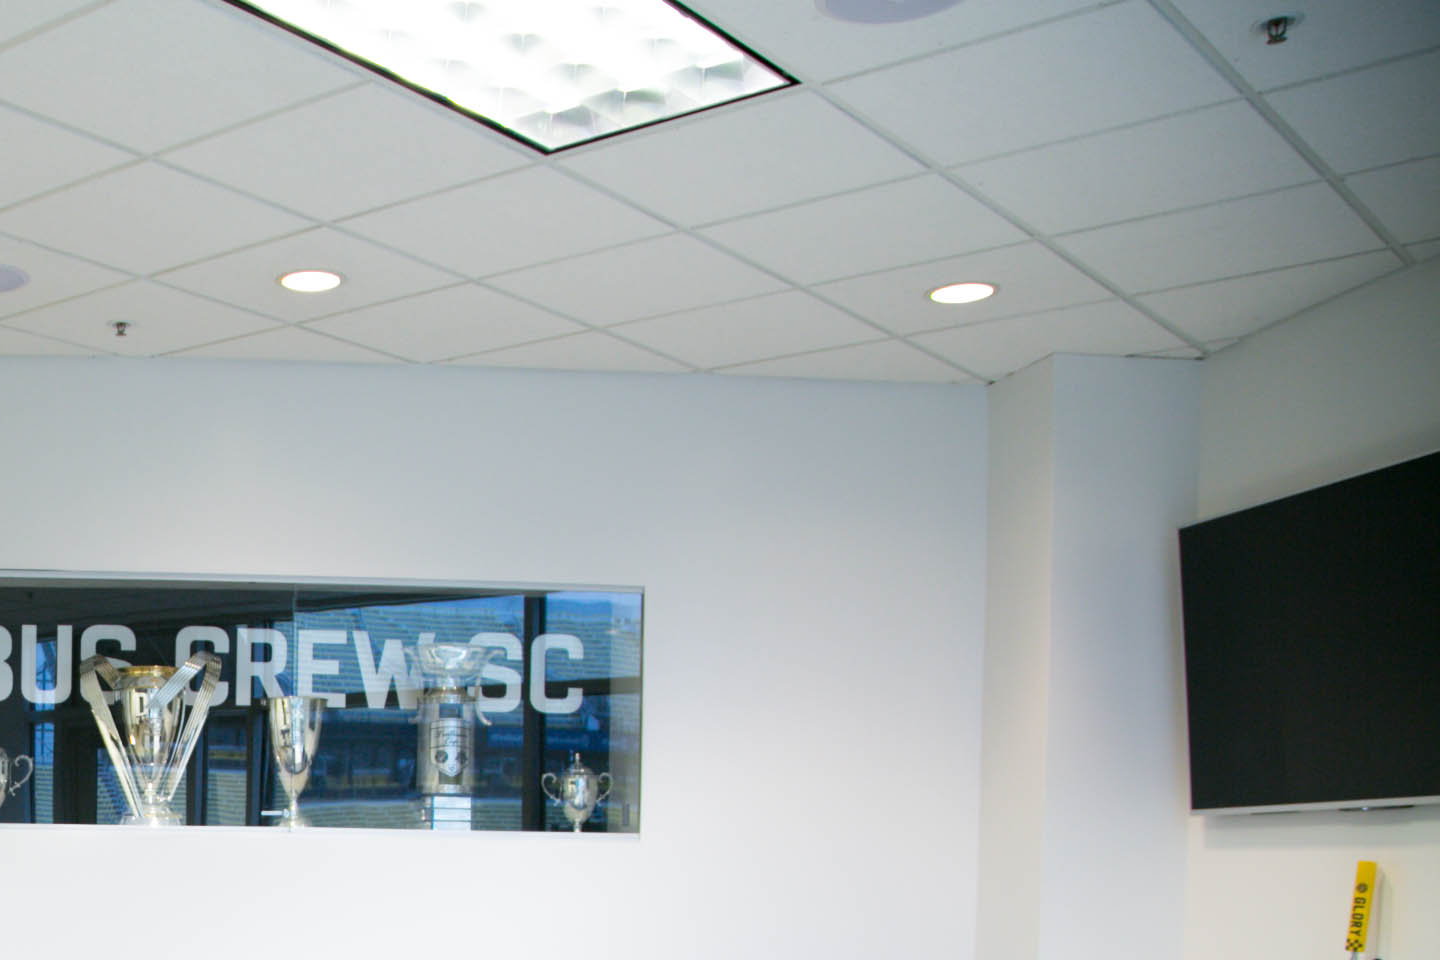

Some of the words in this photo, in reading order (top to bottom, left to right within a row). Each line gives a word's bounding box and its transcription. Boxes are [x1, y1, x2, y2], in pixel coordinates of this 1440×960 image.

[175, 625, 436, 710] CREW
[467, 632, 584, 714] SC
[1350, 896, 1367, 937] GLORY
